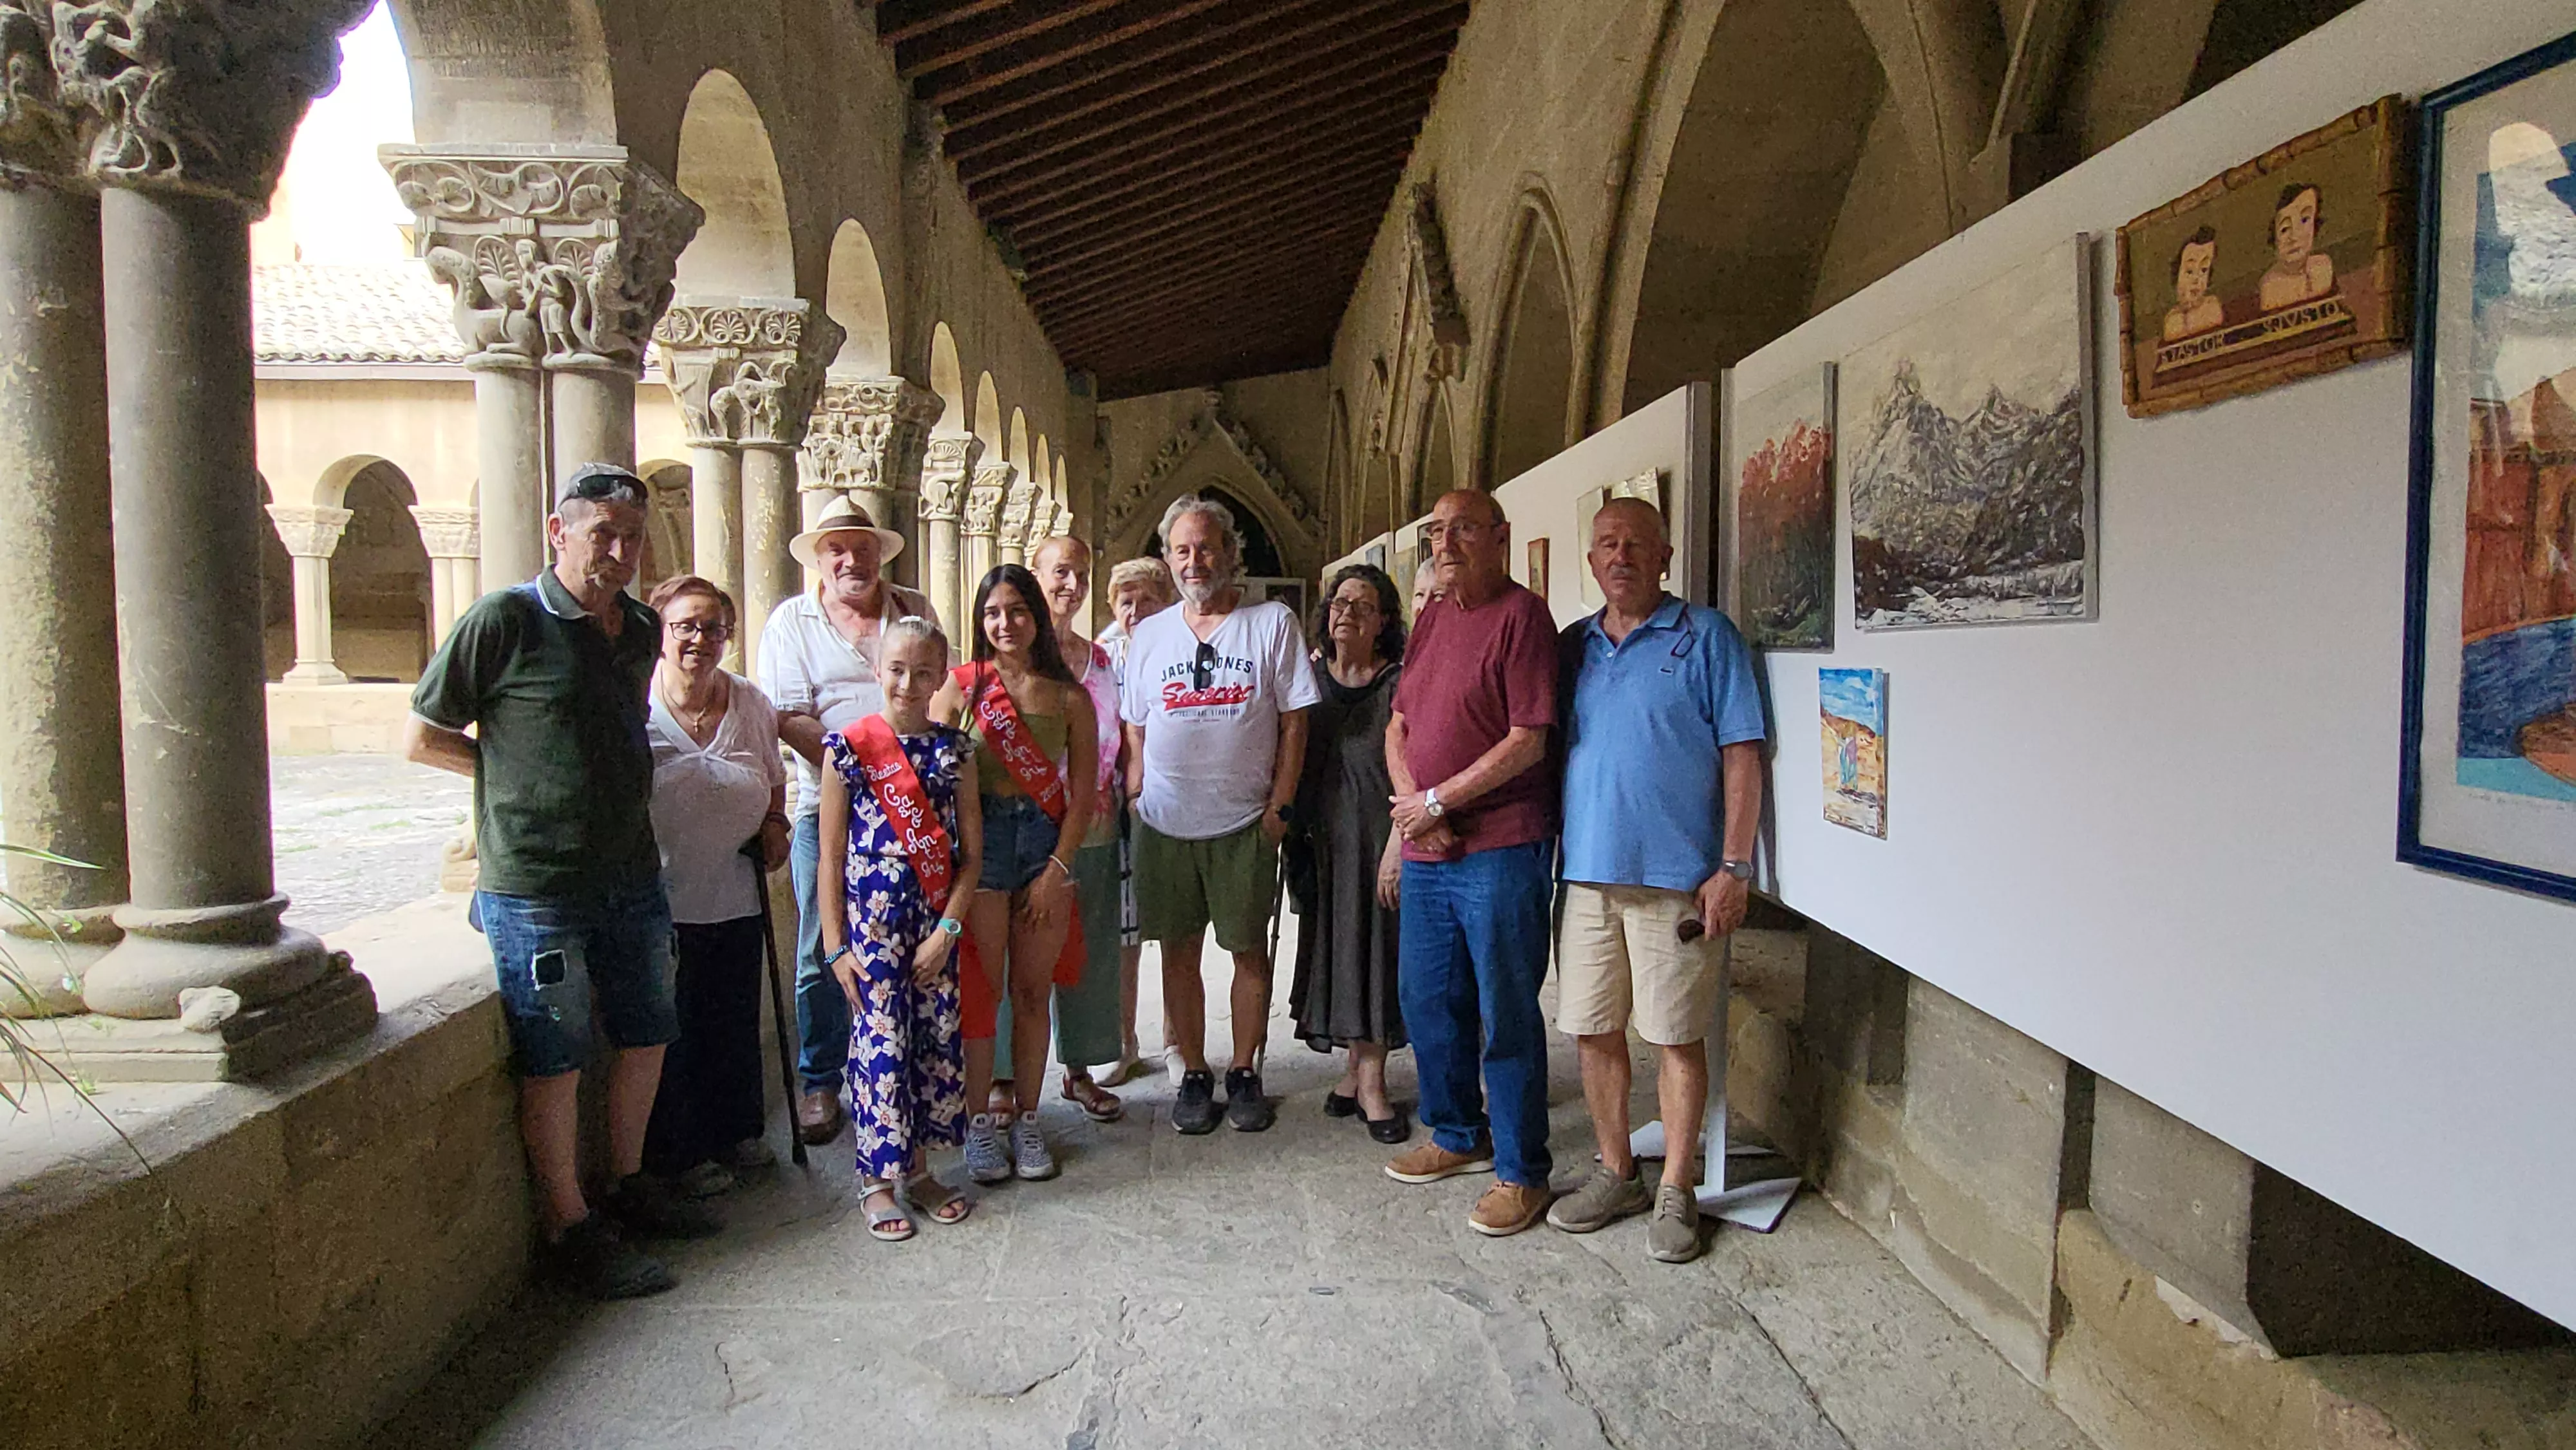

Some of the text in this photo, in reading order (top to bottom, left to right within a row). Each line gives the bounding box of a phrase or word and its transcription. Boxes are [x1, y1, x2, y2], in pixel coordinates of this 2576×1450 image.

[1161, 661, 1195, 682] JACK
[980, 701, 1016, 739] Casco
[884, 783, 923, 829] Casco
